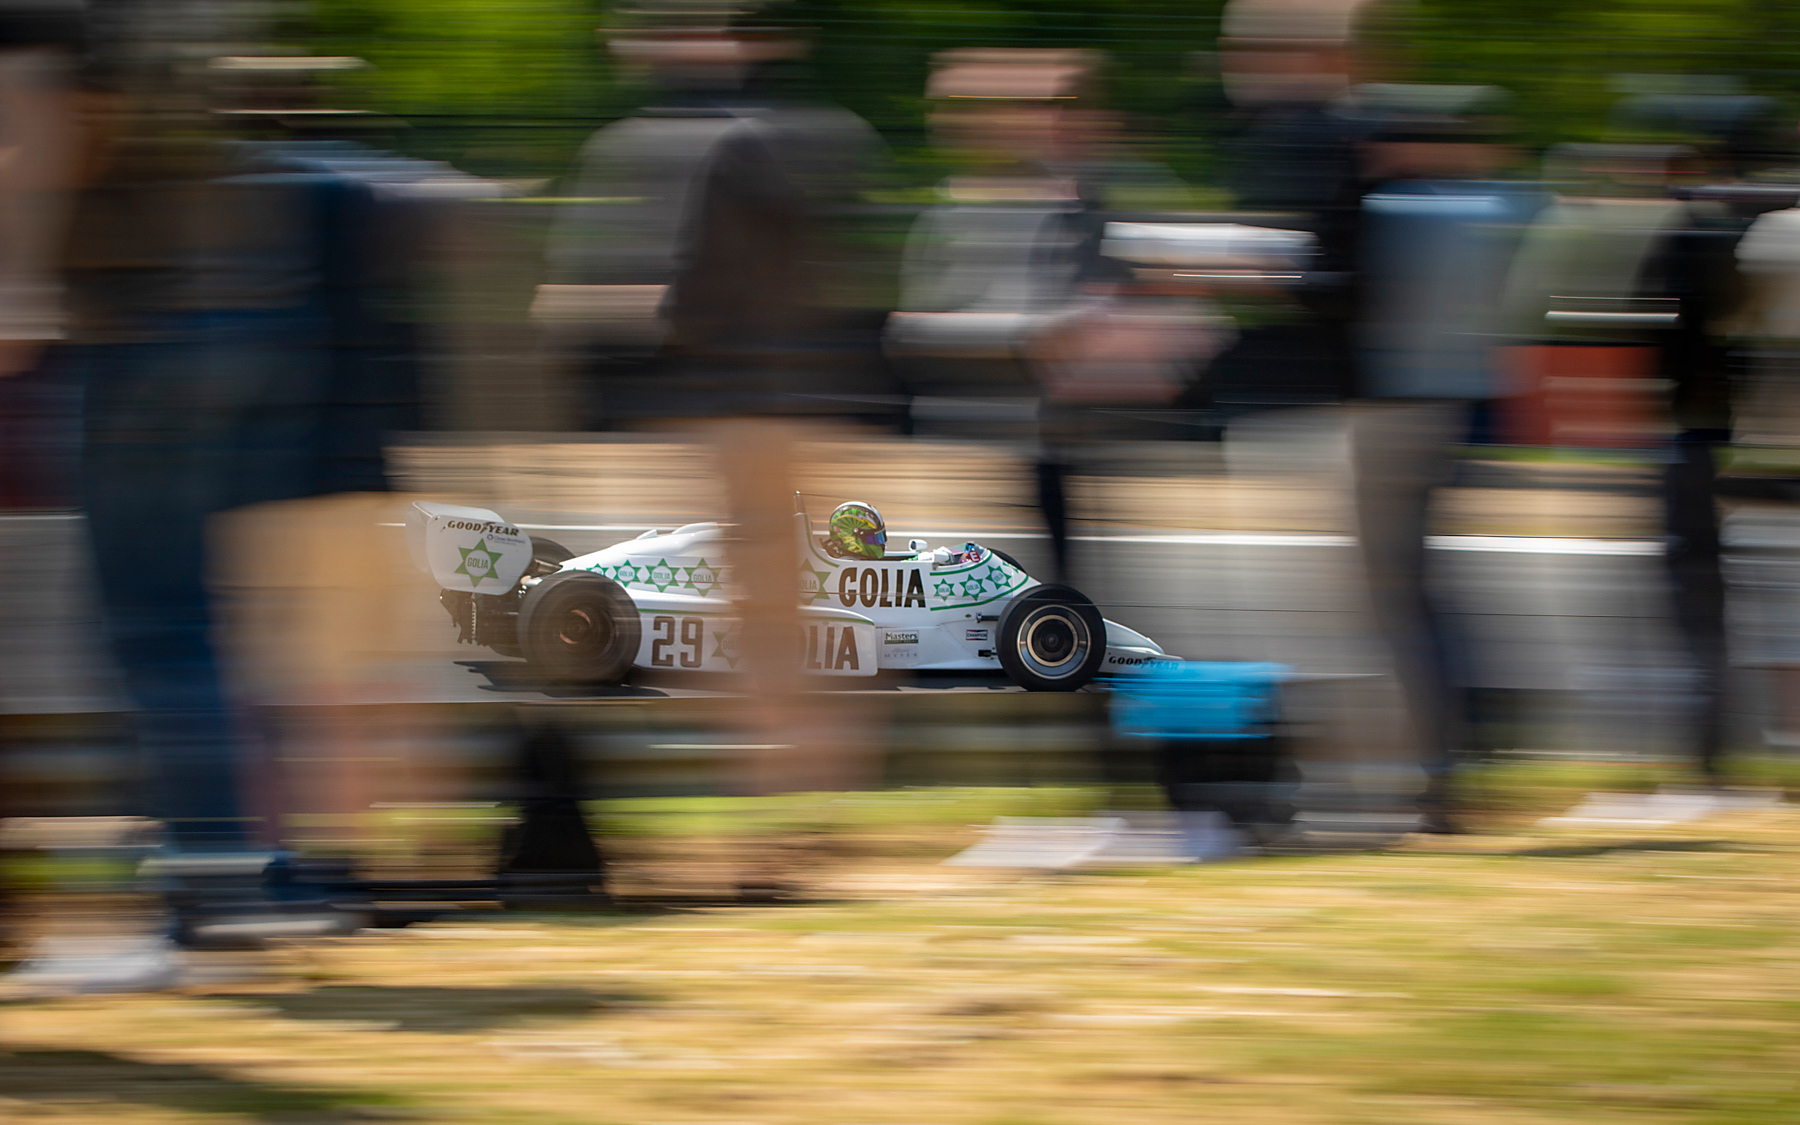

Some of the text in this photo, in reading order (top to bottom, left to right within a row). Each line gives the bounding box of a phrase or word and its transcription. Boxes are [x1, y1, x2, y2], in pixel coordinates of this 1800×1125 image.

[447, 520, 520, 536] GOODYEAR
[969, 551, 978, 562] E
[467, 556, 489, 570] GOLIA
[653, 572, 671, 580] GOLIA
[693, 574, 713, 583] GOLIA
[800, 579, 818, 591] OLIA
[839, 567, 926, 608] GOLIA
[652, 616, 704, 668] 29
[885, 632, 918, 640] Masters
